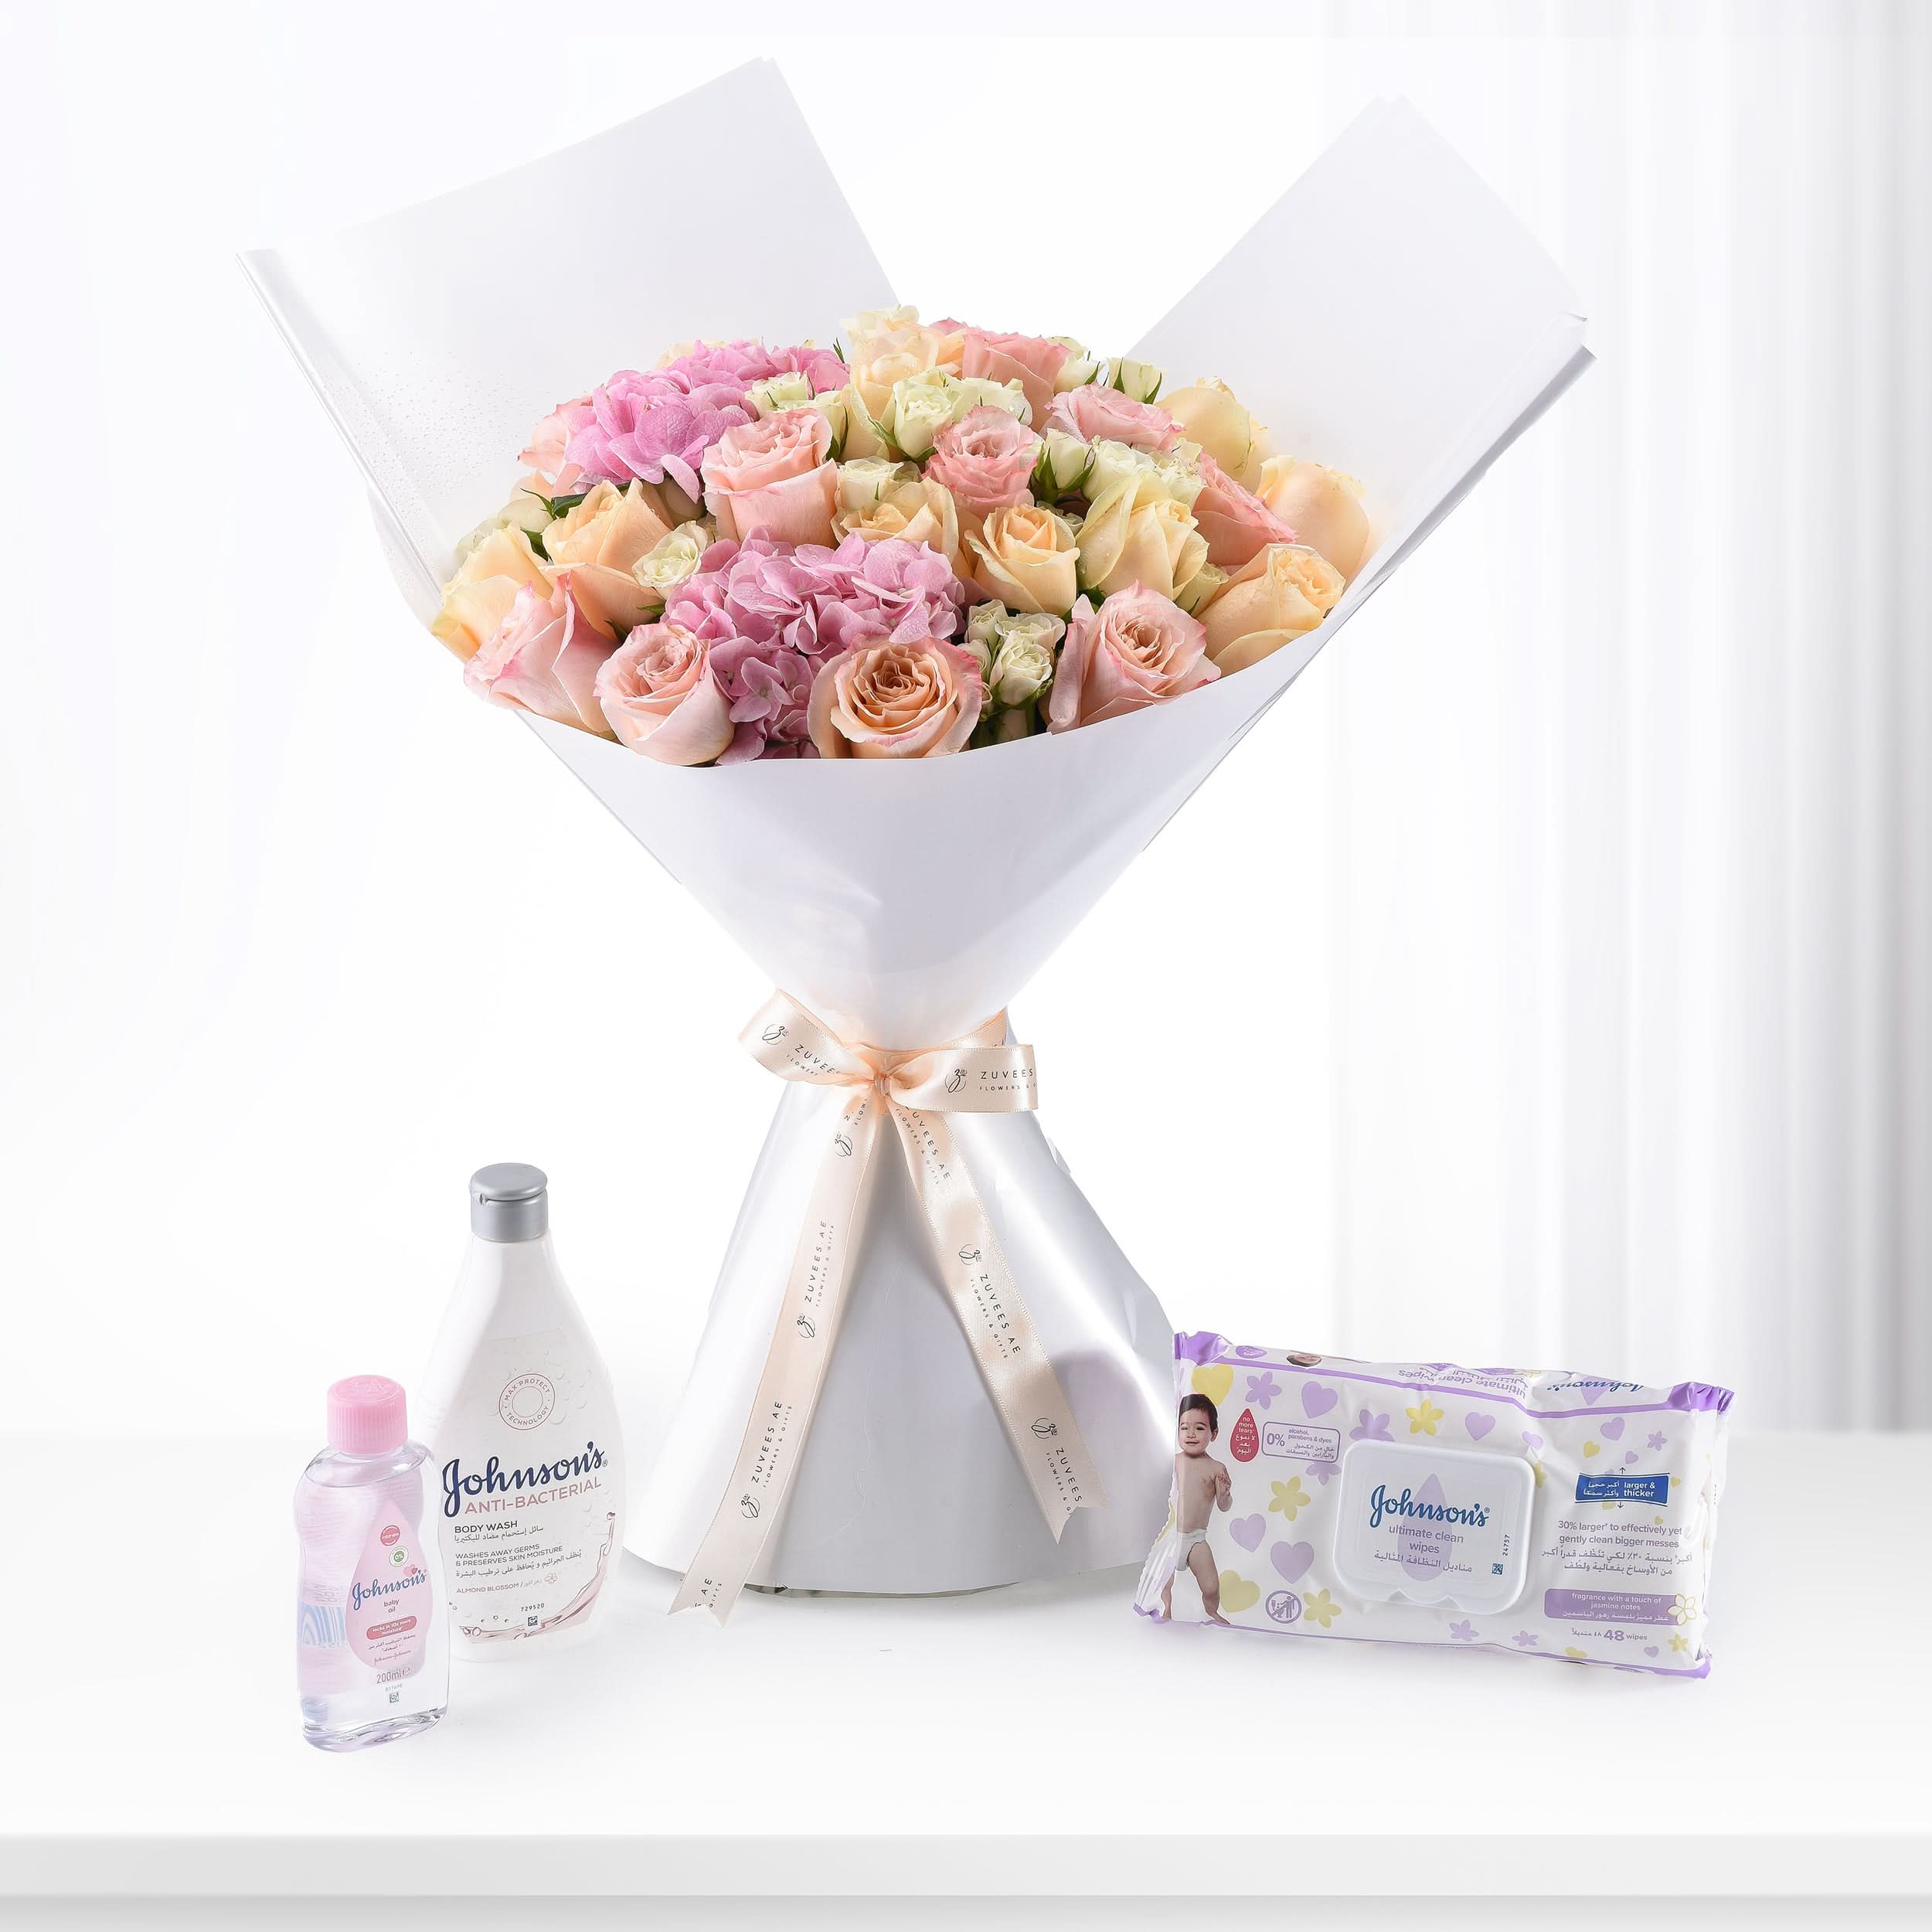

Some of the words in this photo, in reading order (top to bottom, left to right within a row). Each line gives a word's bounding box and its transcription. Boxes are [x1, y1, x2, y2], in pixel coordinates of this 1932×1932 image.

[980, 1068, 1034, 1080] ZUVEES
[505, 1384, 518, 1401] MAX
[519, 1378, 550, 1393] PROTECT
[506, 1405, 549, 1426] TECHNOLOGY
[1267, 1433, 1286, 1447] 0%
[1056, 1447, 1083, 1502] ZUVEES
[1624, 1481, 1648, 1490] larger
[464, 1476, 602, 1515] ANTI-BACTERIAL
[1624, 1489, 1655, 1498] thicker
[454, 1524, 484, 1533] BODY
[485, 1520, 518, 1531] WASH
[1558, 1520, 1577, 1530] 30%
[1621, 1523, 1667, 1536] effectively
[1668, 1527, 1682, 1536] yet
[1389, 1525, 1433, 1539] ultimate
[1435, 1530, 1464, 1543] clean
[1409, 1541, 1440, 1554] wipes
[1502, 1534, 1511, 1556] 24757
[1559, 1534, 1587, 1544] gently
[1588, 1535, 1613, 1544] clean
[1615, 1536, 1645, 1547] bigger
[1646, 1539, 1679, 1548] messes
[463, 1557, 508, 1566] PRESERVES
[509, 1553, 526, 1562] SKIN
[526, 1546, 563, 1559] MOISTURE
[490, 1549, 513, 1557] AWAY
[514, 1544, 540, 1553] GERMS
[1406, 1554, 1441, 1568] النظافة
[1443, 1560, 1472, 1573] مناديل
[487, 1583, 519, 1591] BLOSSOM
[383, 1598, 400, 1607] baby
[1571, 1592, 1606, 1603] fragrance
[1608, 1594, 1624, 1602] with
[520, 1603, 545, 1612] 729520
[1590, 1600, 1619, 1610] jasmine
[1604, 1628, 1624, 1641] 48
[376, 1668, 402, 1684] 200ml
